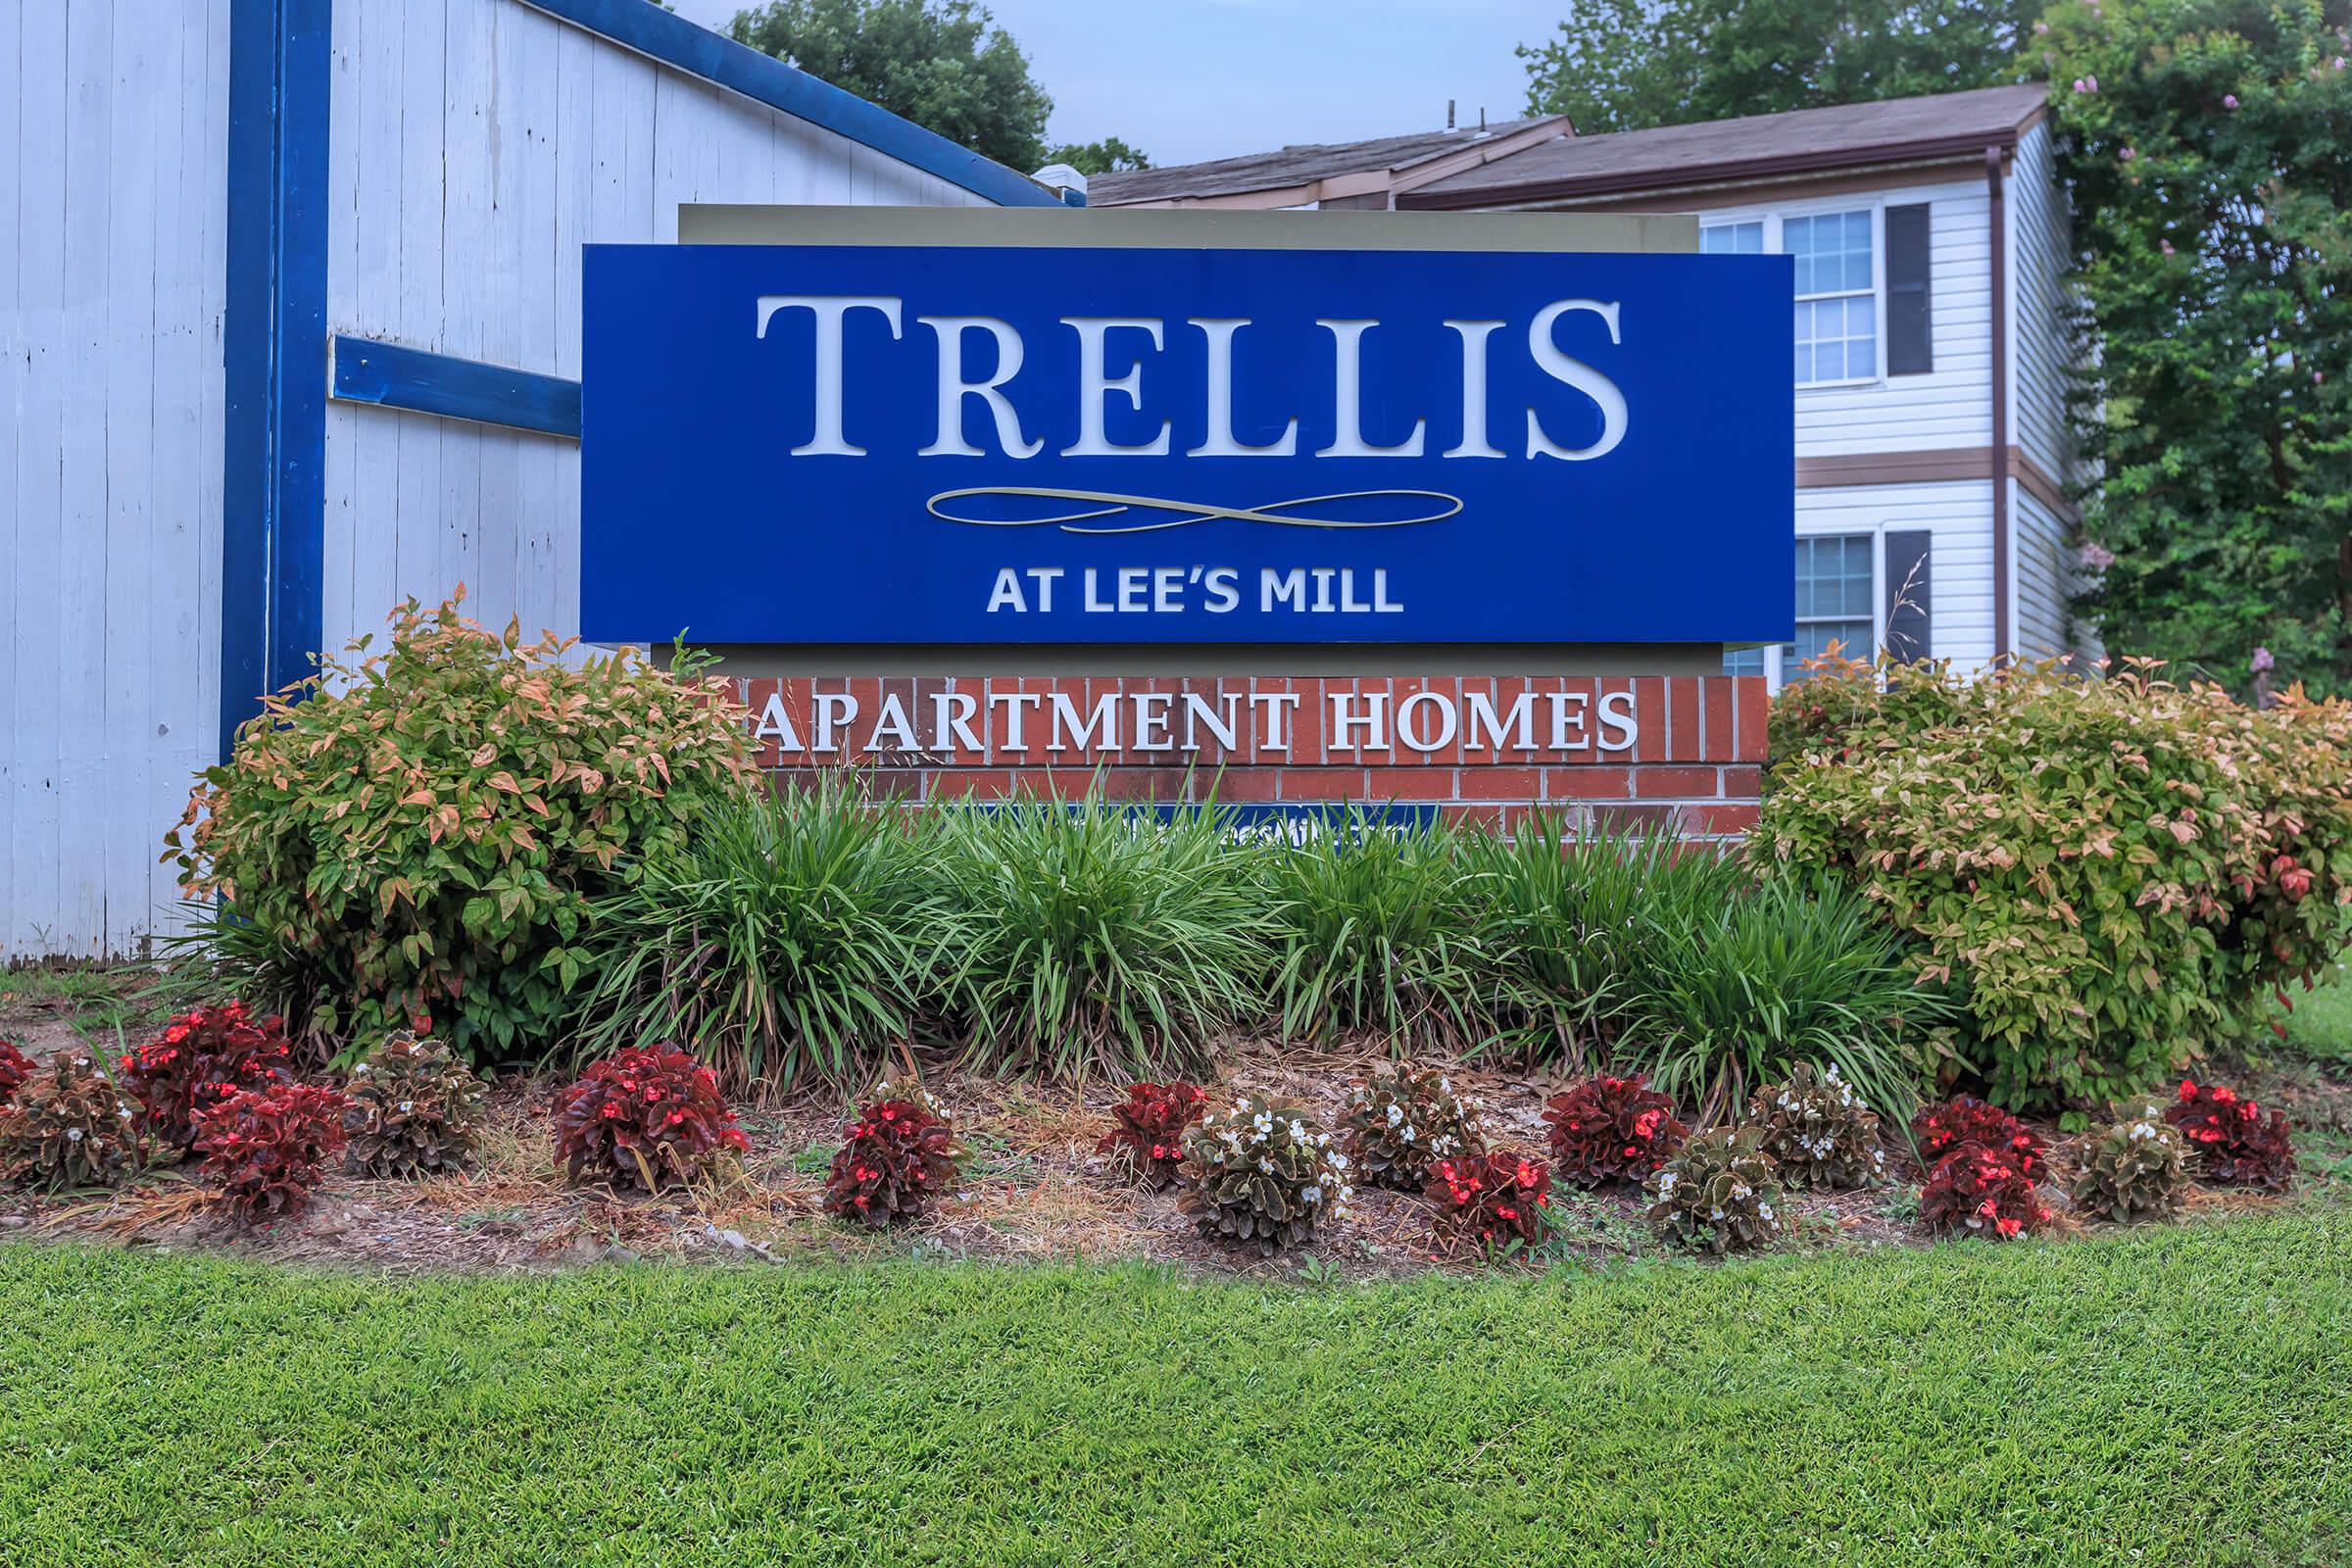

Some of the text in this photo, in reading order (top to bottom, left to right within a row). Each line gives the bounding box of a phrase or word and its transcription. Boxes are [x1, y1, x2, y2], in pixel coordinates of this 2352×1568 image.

[756, 296, 1629, 461] TRELLIS
[986, 567, 1405, 614] AT LEE’S MILL
[749, 692, 1639, 752] APARTMENT HOMES
